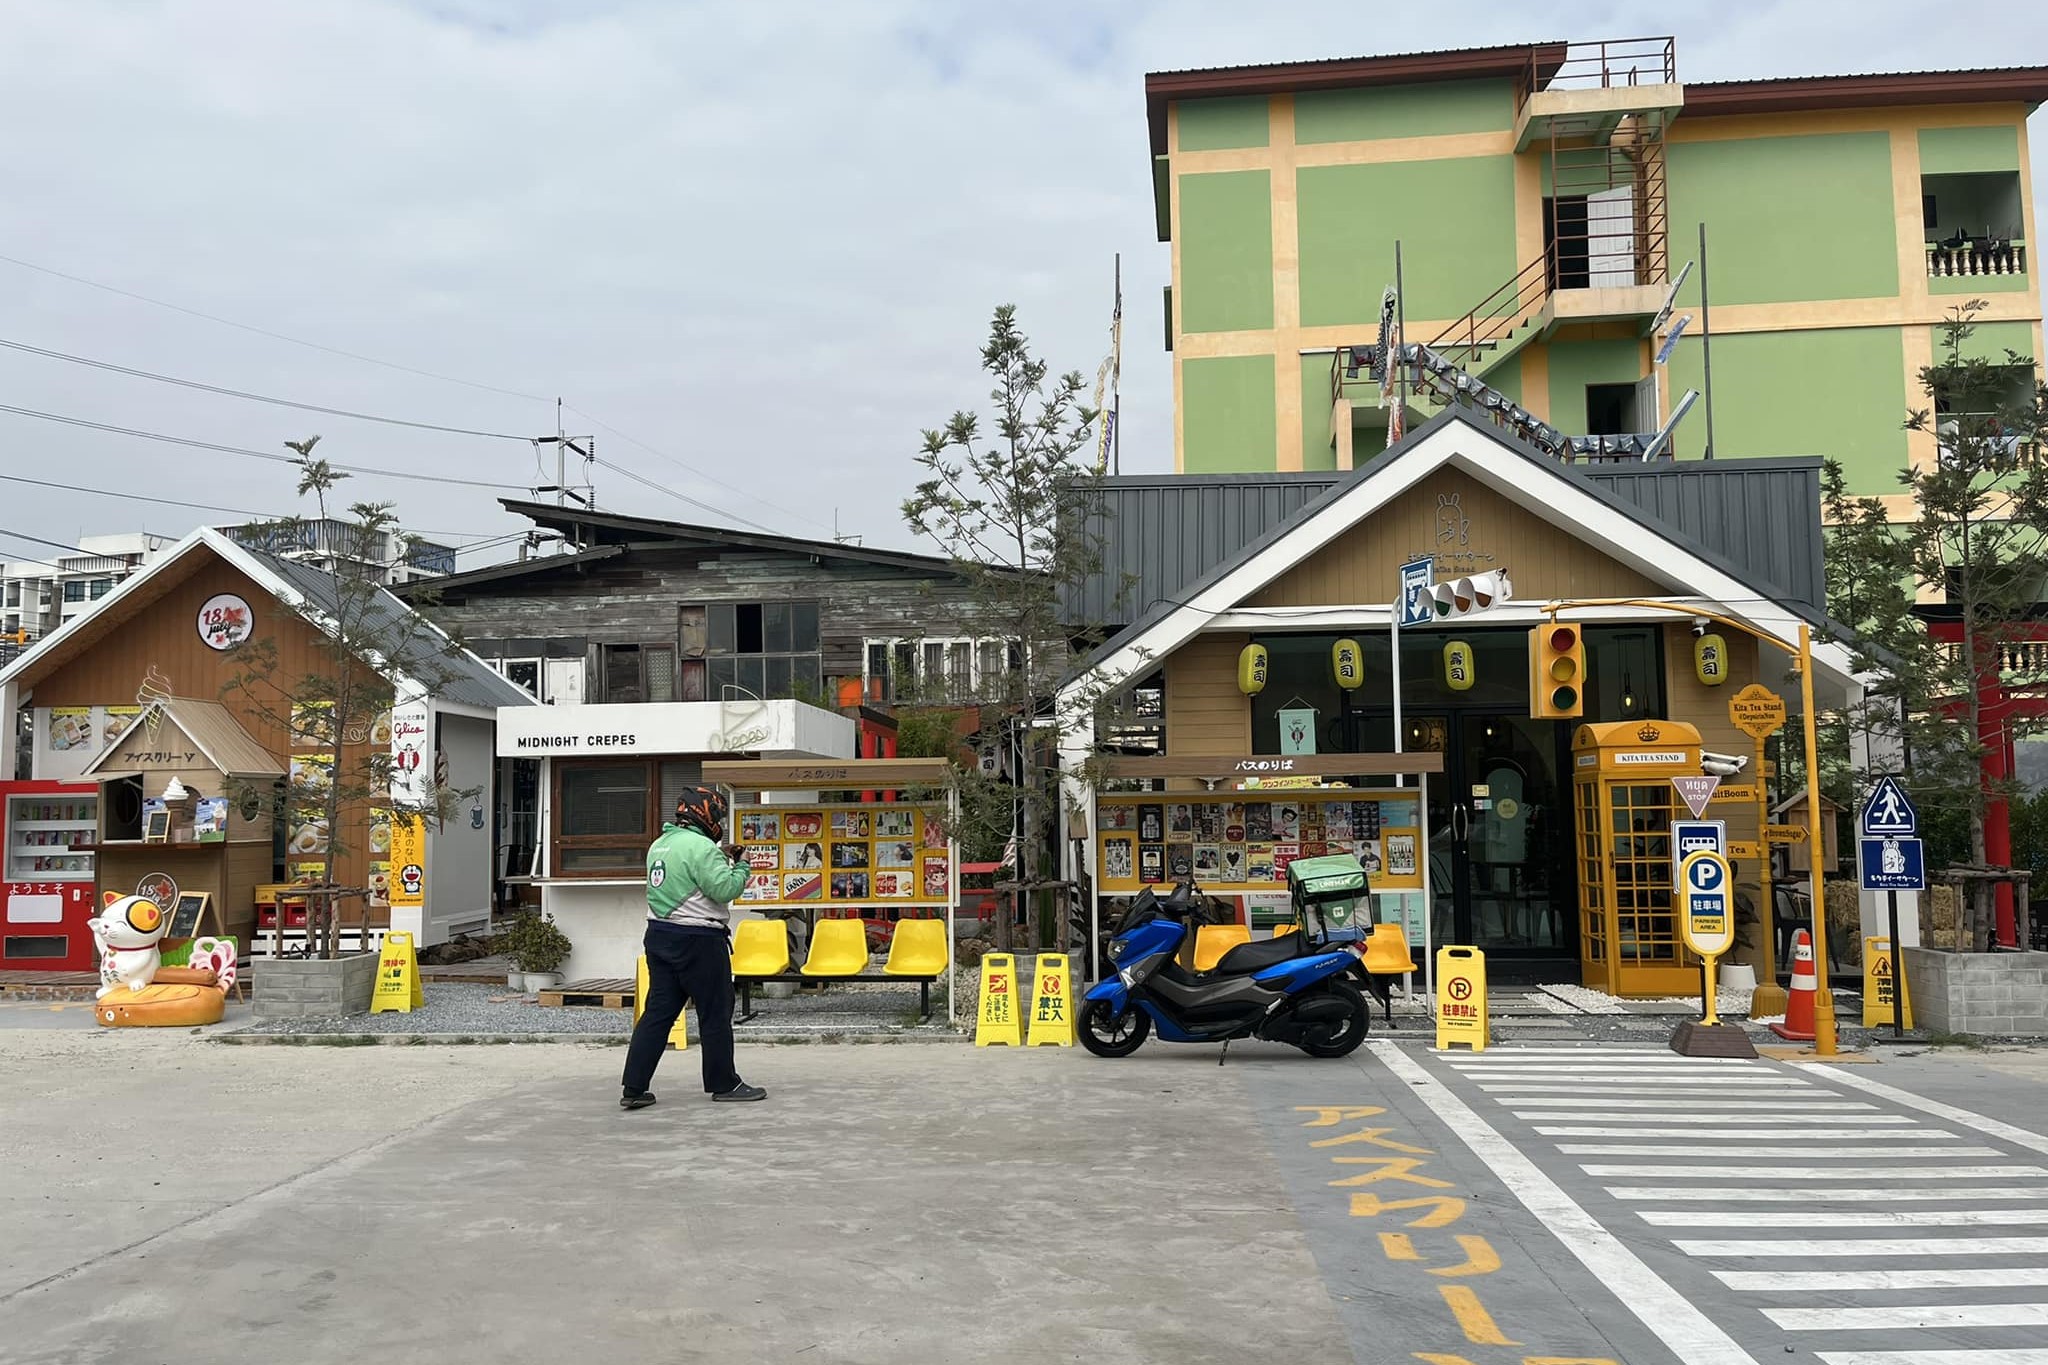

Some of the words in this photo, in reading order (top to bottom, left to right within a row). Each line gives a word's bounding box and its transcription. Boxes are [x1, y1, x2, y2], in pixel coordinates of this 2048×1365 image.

[203, 607, 222, 625] 18
[1750, 703, 1761, 711] Tea
[1764, 702, 1782, 711] Stand
[394, 722, 425, 739] Glico
[517, 736, 578, 748] MIDNIGHT
[587, 735, 636, 747] CREPES
[1235, 760, 1294, 771] バスのりば
[1685, 781, 1709, 793] หยุด
[1729, 845, 1746, 854] Tea
[9, 883, 65, 895] ようこそ
